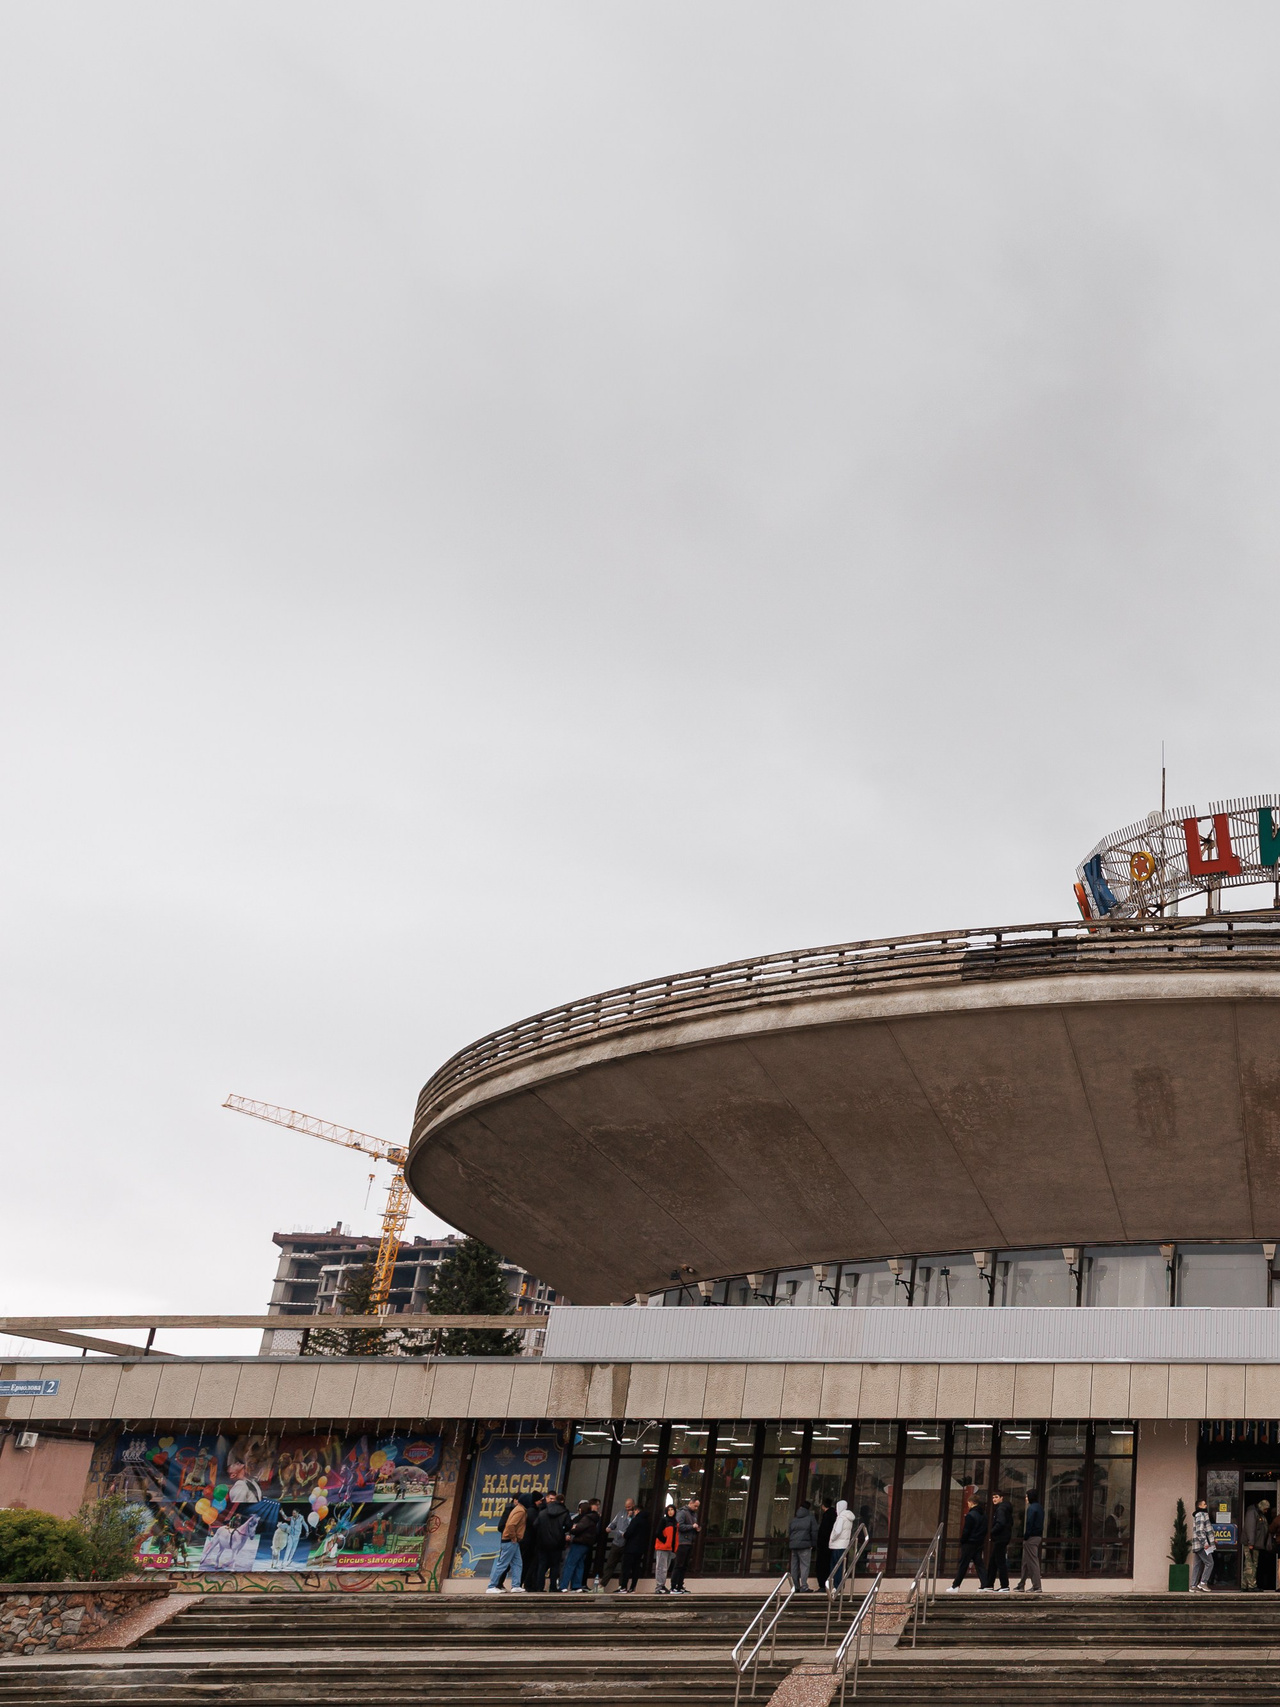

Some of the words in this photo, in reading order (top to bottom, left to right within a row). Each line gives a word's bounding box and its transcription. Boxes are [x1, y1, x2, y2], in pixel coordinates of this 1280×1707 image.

[46, 1381, 56, 1393] 2
[482, 1474, 551, 1494] КАССЫ
[479, 1498, 513, 1519] ЦИ
